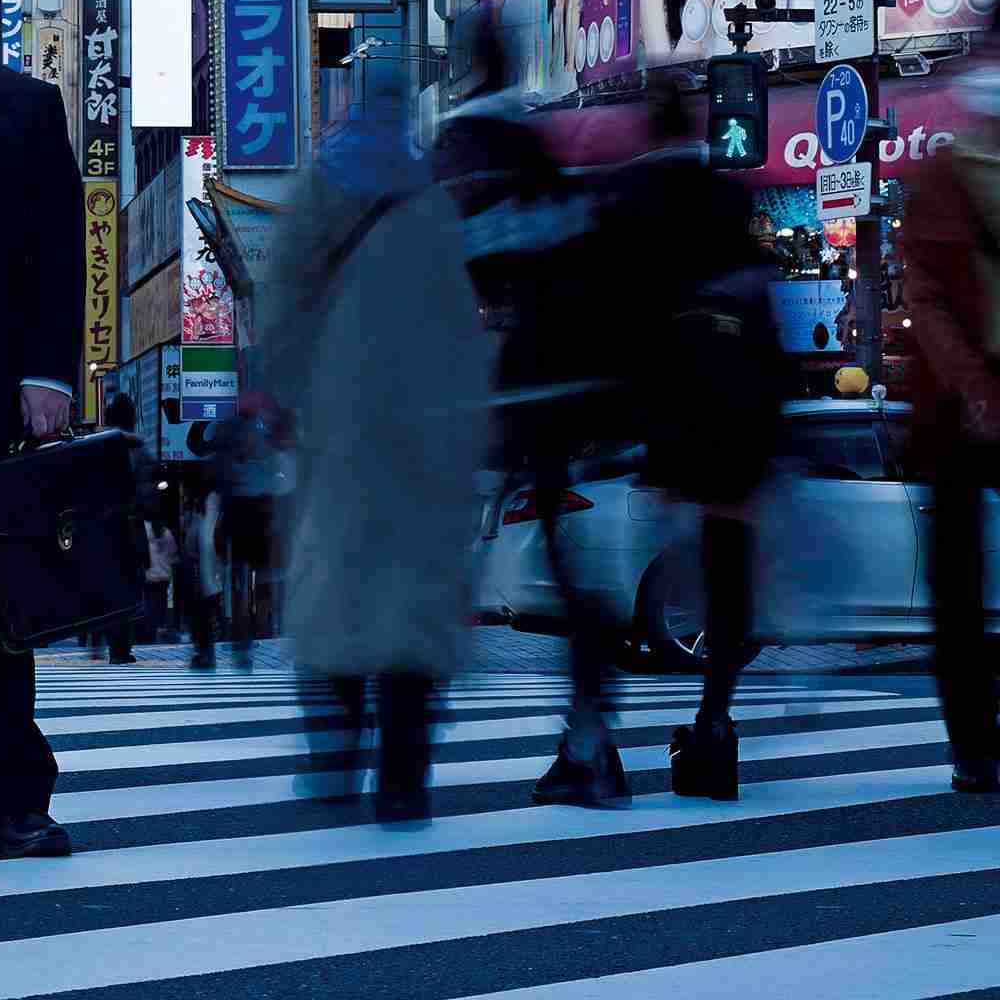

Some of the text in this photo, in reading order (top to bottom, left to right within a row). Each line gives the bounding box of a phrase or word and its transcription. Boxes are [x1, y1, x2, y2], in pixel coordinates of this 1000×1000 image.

[85, 28, 118, 125] 甘太郎
[827, 90, 846, 149] P
[840, 120, 855, 147] 40
[89, 139, 115, 154] 4F
[89, 160, 115, 176] 3F
[184, 378, 235, 391] FamilyMart
